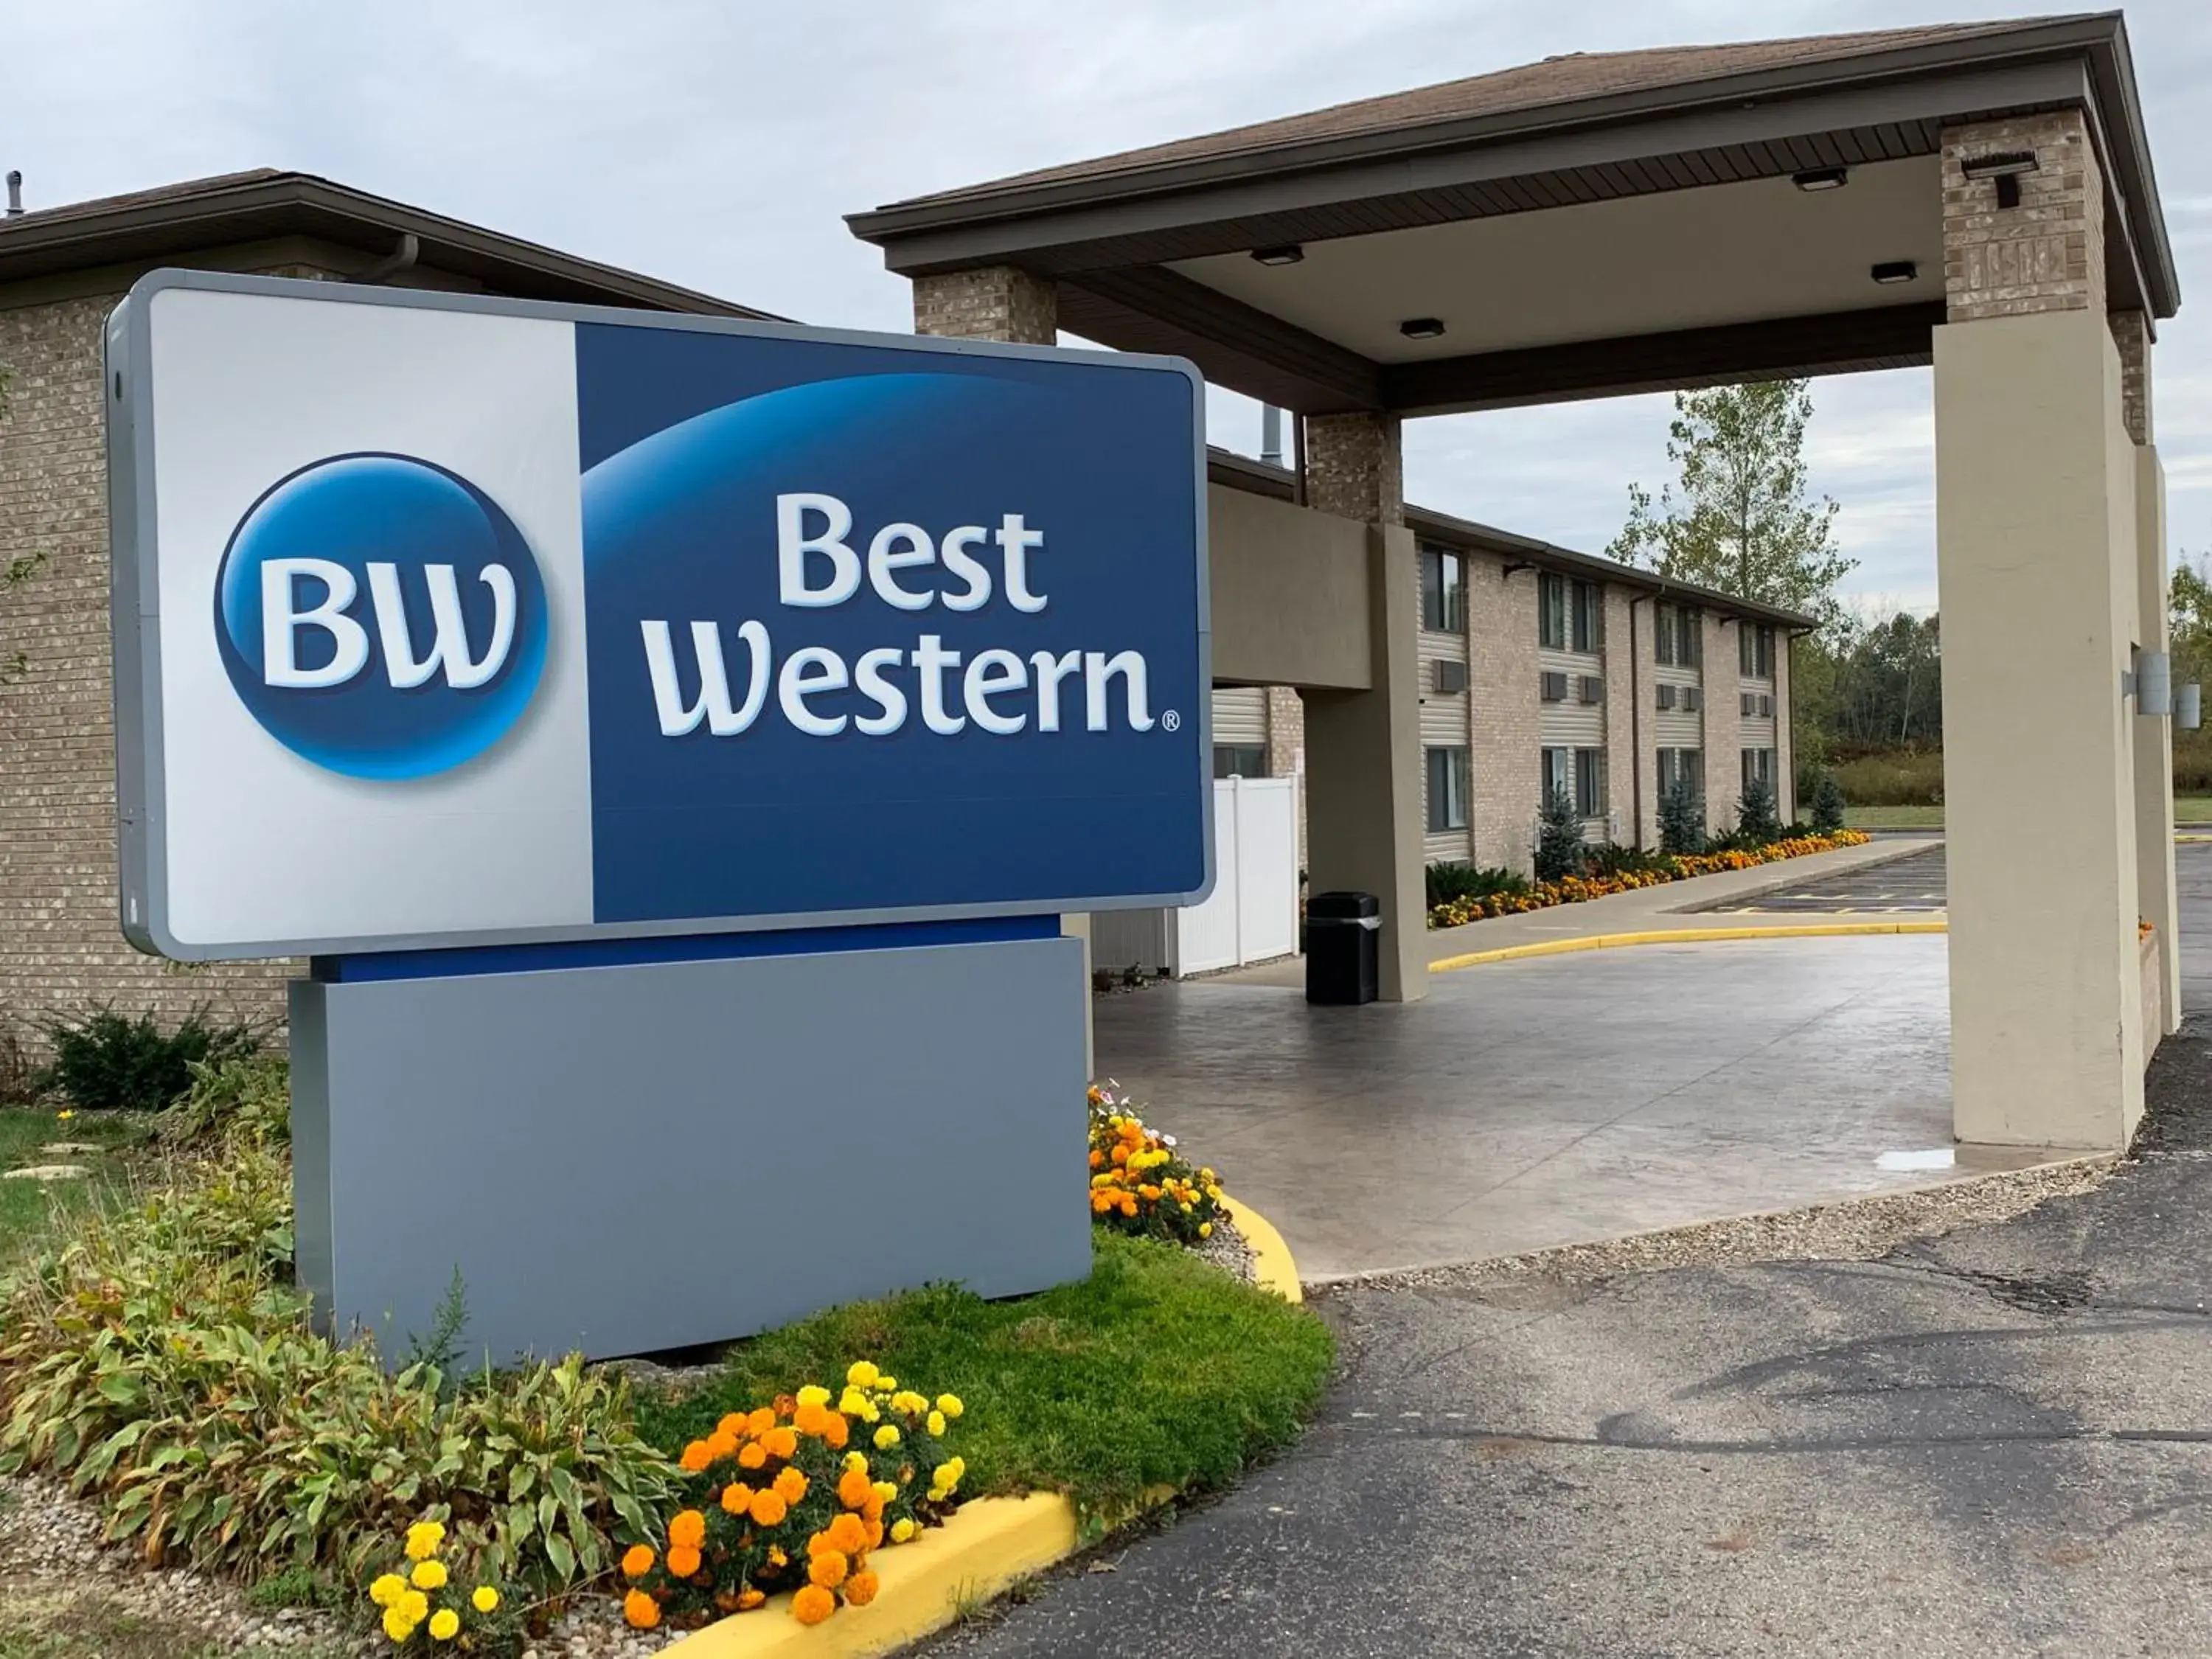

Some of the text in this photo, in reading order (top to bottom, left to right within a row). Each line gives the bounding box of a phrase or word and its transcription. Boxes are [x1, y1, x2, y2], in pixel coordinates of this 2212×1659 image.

[776, 493, 1048, 611] Best
[260, 557, 515, 689] BW
[640, 619, 1155, 737] Western
